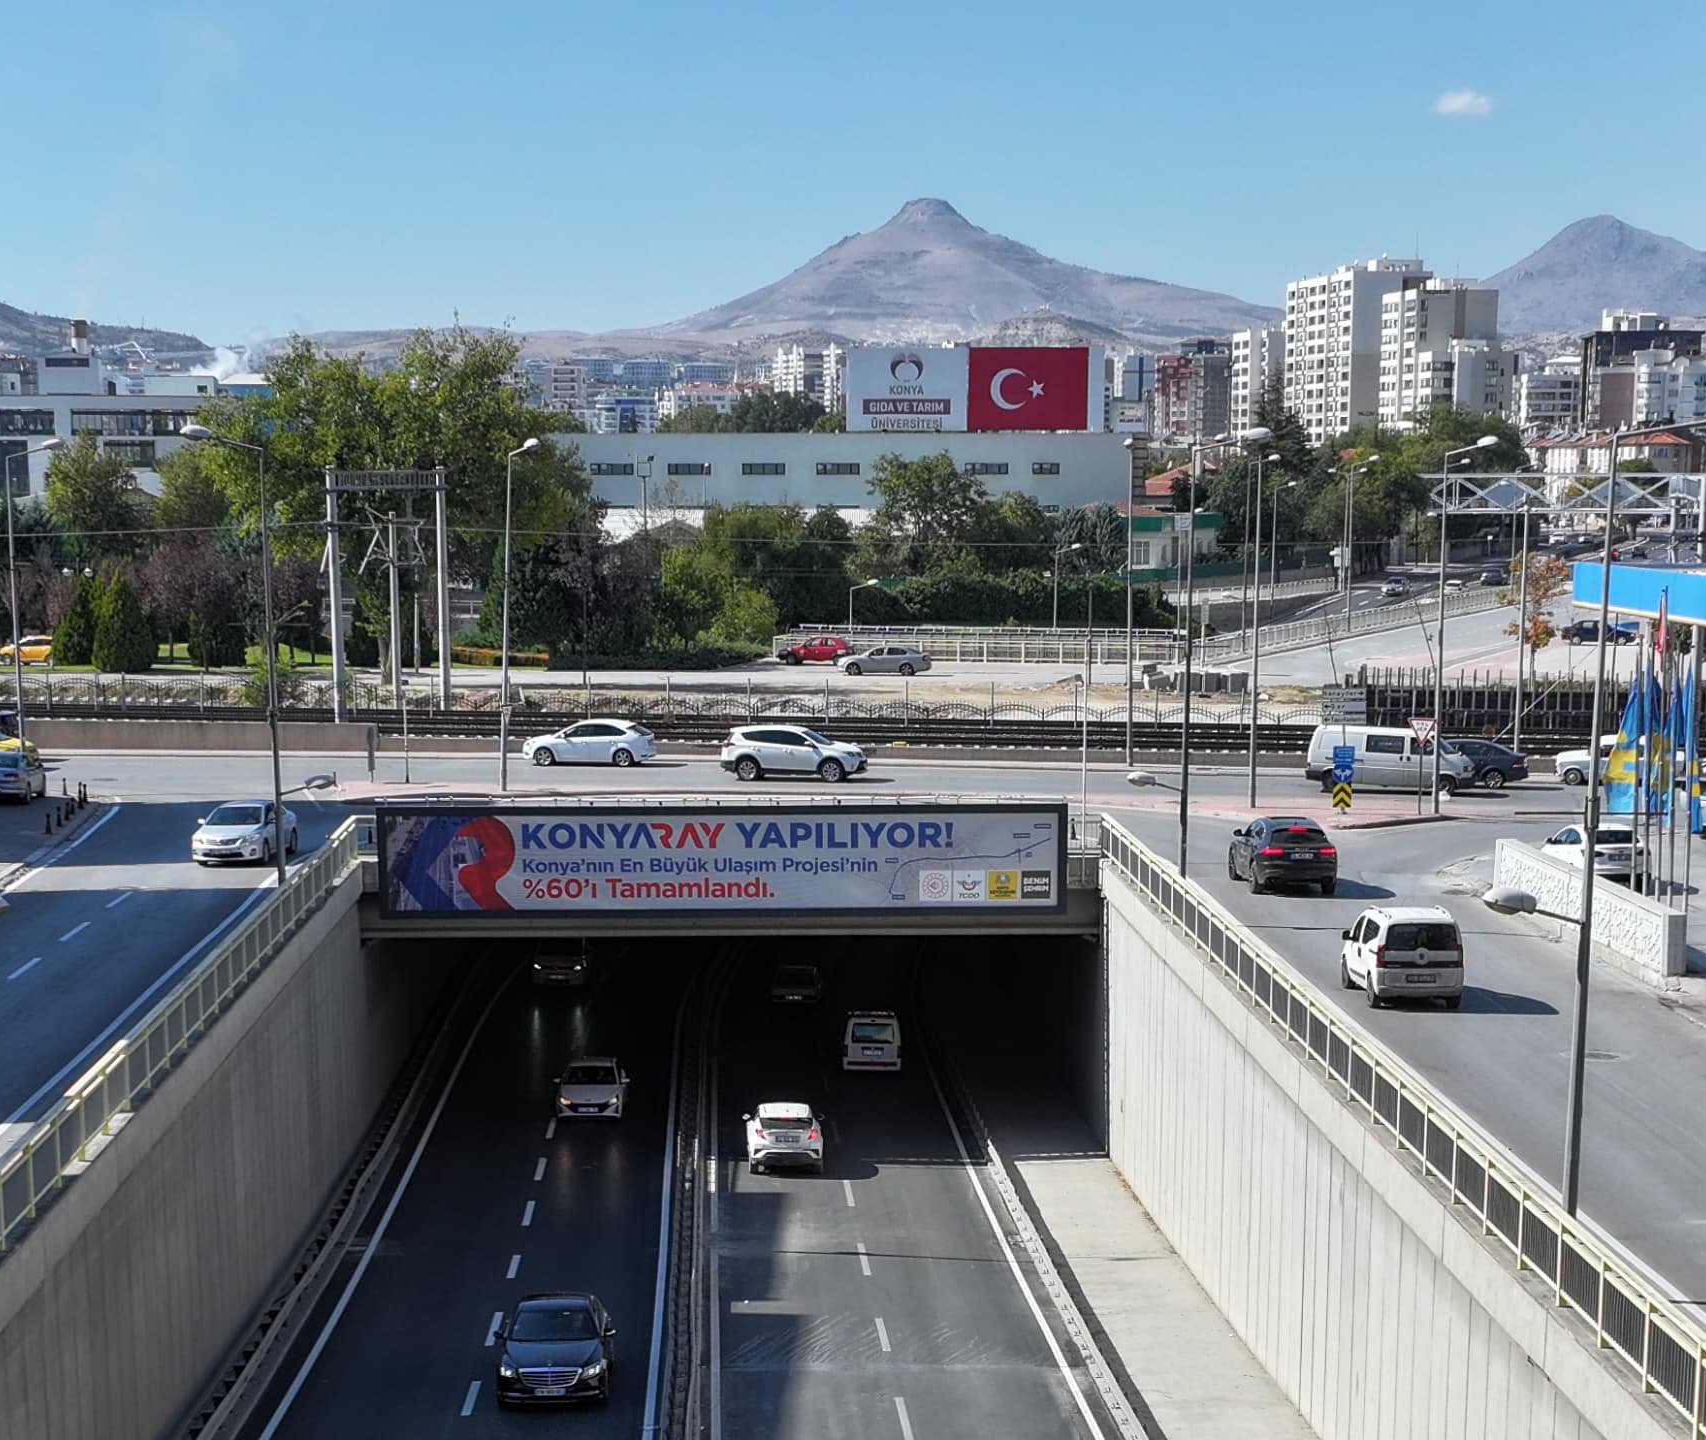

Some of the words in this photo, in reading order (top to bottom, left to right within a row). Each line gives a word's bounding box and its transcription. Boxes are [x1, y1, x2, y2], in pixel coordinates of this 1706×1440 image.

[889, 384, 924, 395] KONYA
[869, 402, 894, 412] GIDA
[896, 402, 910, 412] VE
[912, 402, 944, 412] TARIM
[871, 416, 943, 429] ÜNİVERSİTESİ
[521, 823, 725, 849] KONYARAY
[736, 822, 954, 849] YAPILIYOR!
[522, 858, 614, 875] Konya'nın
[621, 859, 643, 873] En
[650, 857, 709, 876] Büyük
[714, 857, 776, 876] Ulaşım
[782, 857, 878, 876] Projesi'nin
[523, 878, 597, 899] %60'ı
[605, 877, 774, 899] Tamamlandı.
